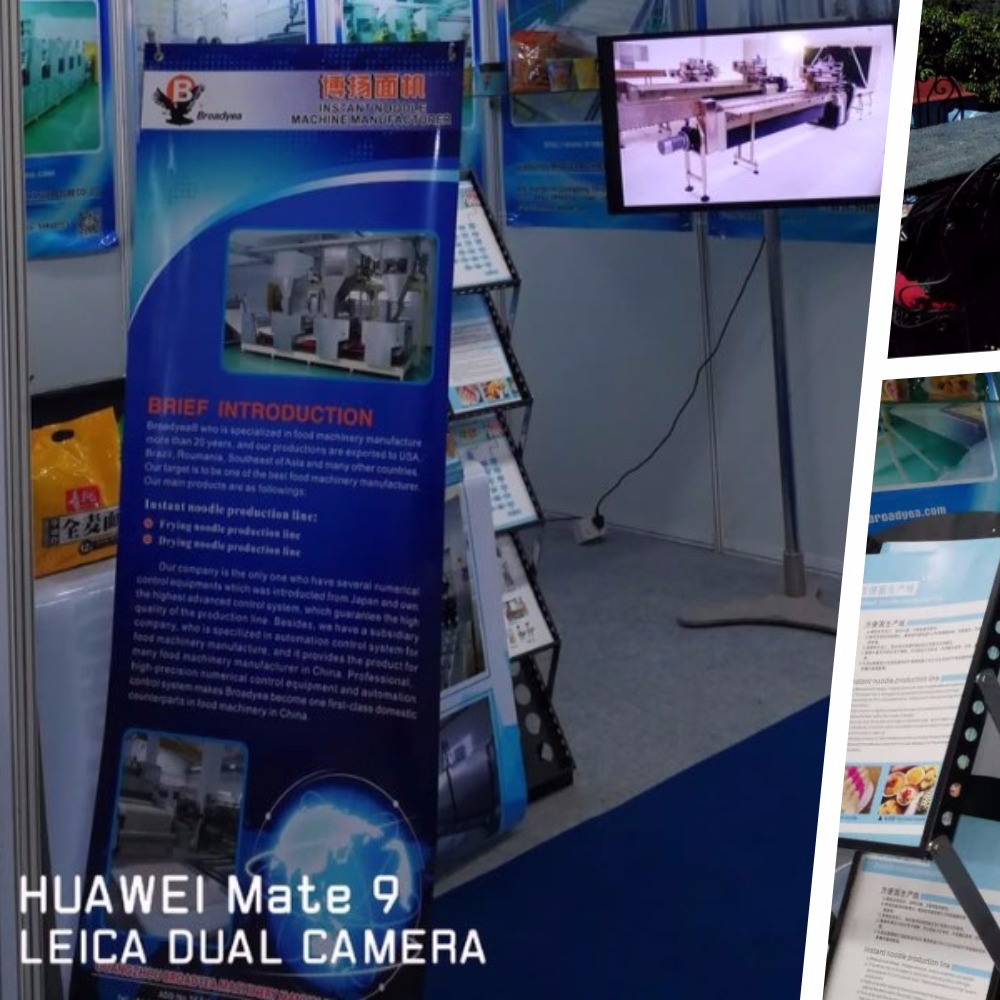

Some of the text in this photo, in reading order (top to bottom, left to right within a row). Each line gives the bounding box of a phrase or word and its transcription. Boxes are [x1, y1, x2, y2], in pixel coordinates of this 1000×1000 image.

[319, 103, 370, 113] INSTANT
[291, 114, 347, 124] MACHINE
[147, 396, 374, 428] BRIEF INTRODUCTION
